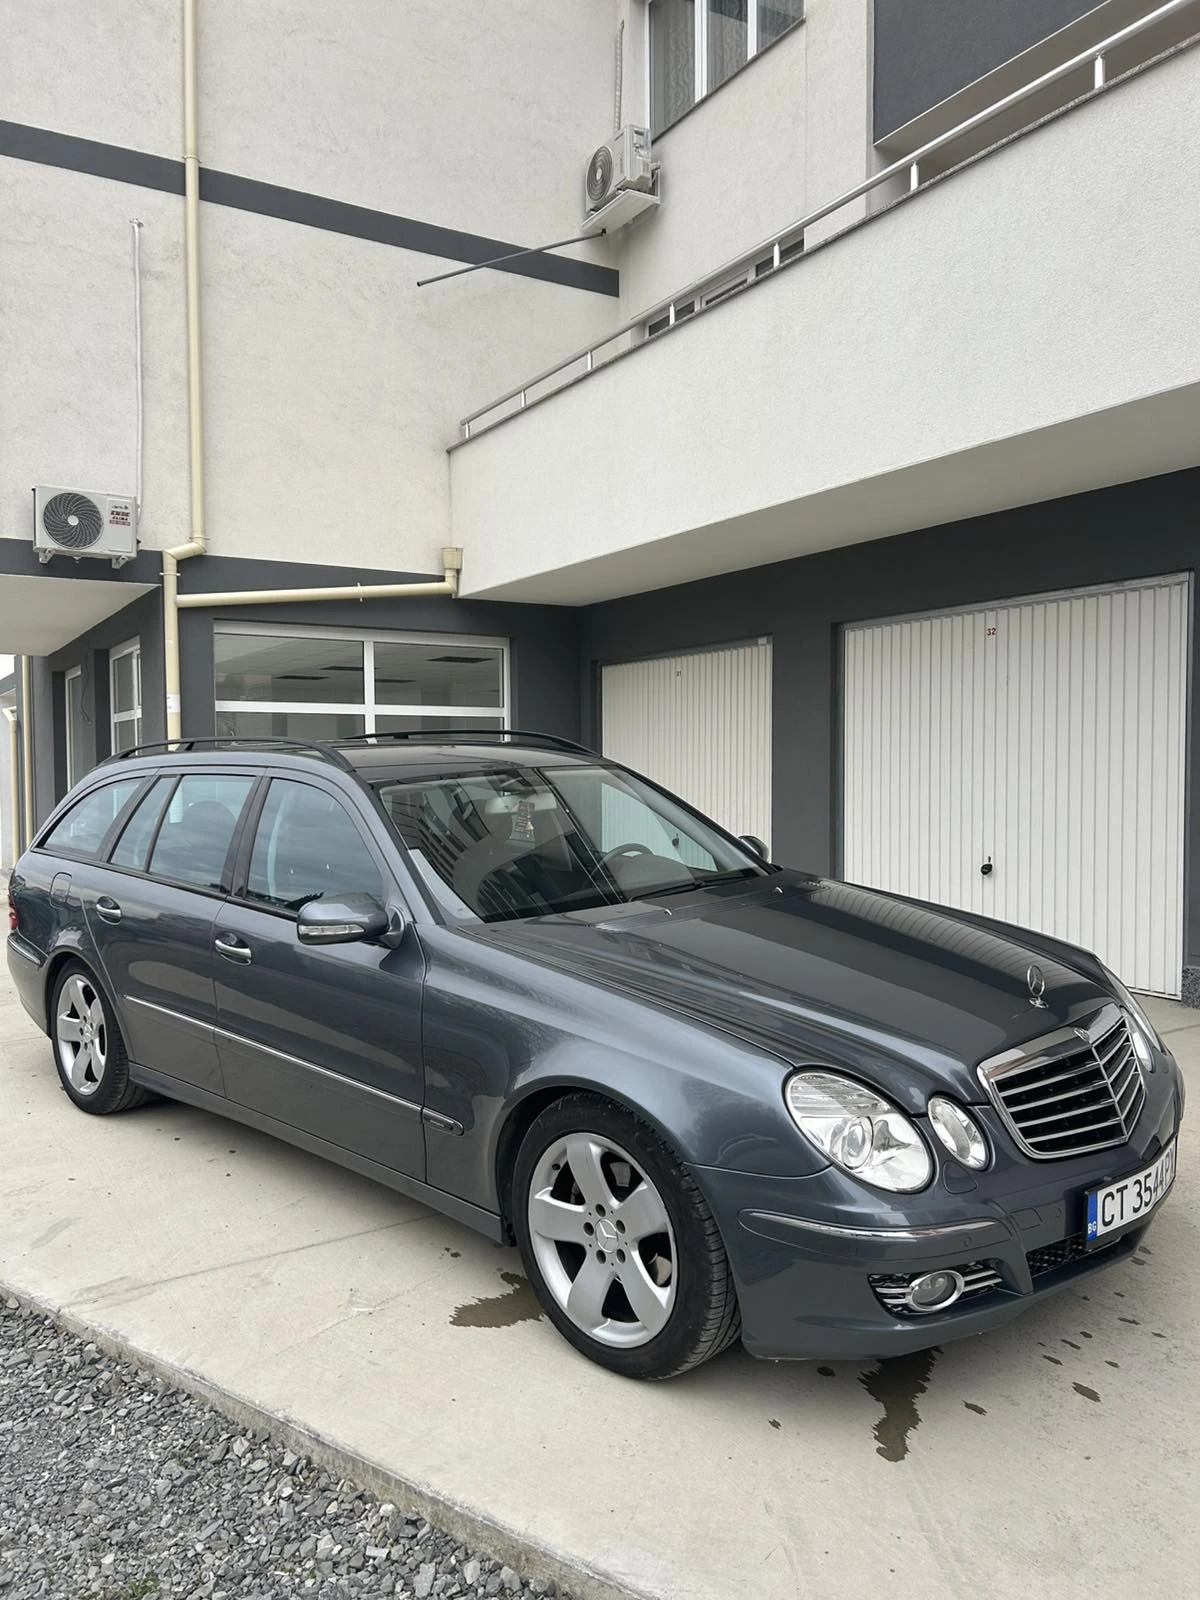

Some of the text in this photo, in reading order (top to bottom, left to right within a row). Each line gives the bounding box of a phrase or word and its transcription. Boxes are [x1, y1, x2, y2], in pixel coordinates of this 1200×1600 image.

[986, 627, 996, 636] 32
[1101, 1184, 1129, 1227] CT
[1087, 1221, 1097, 1234] BG
